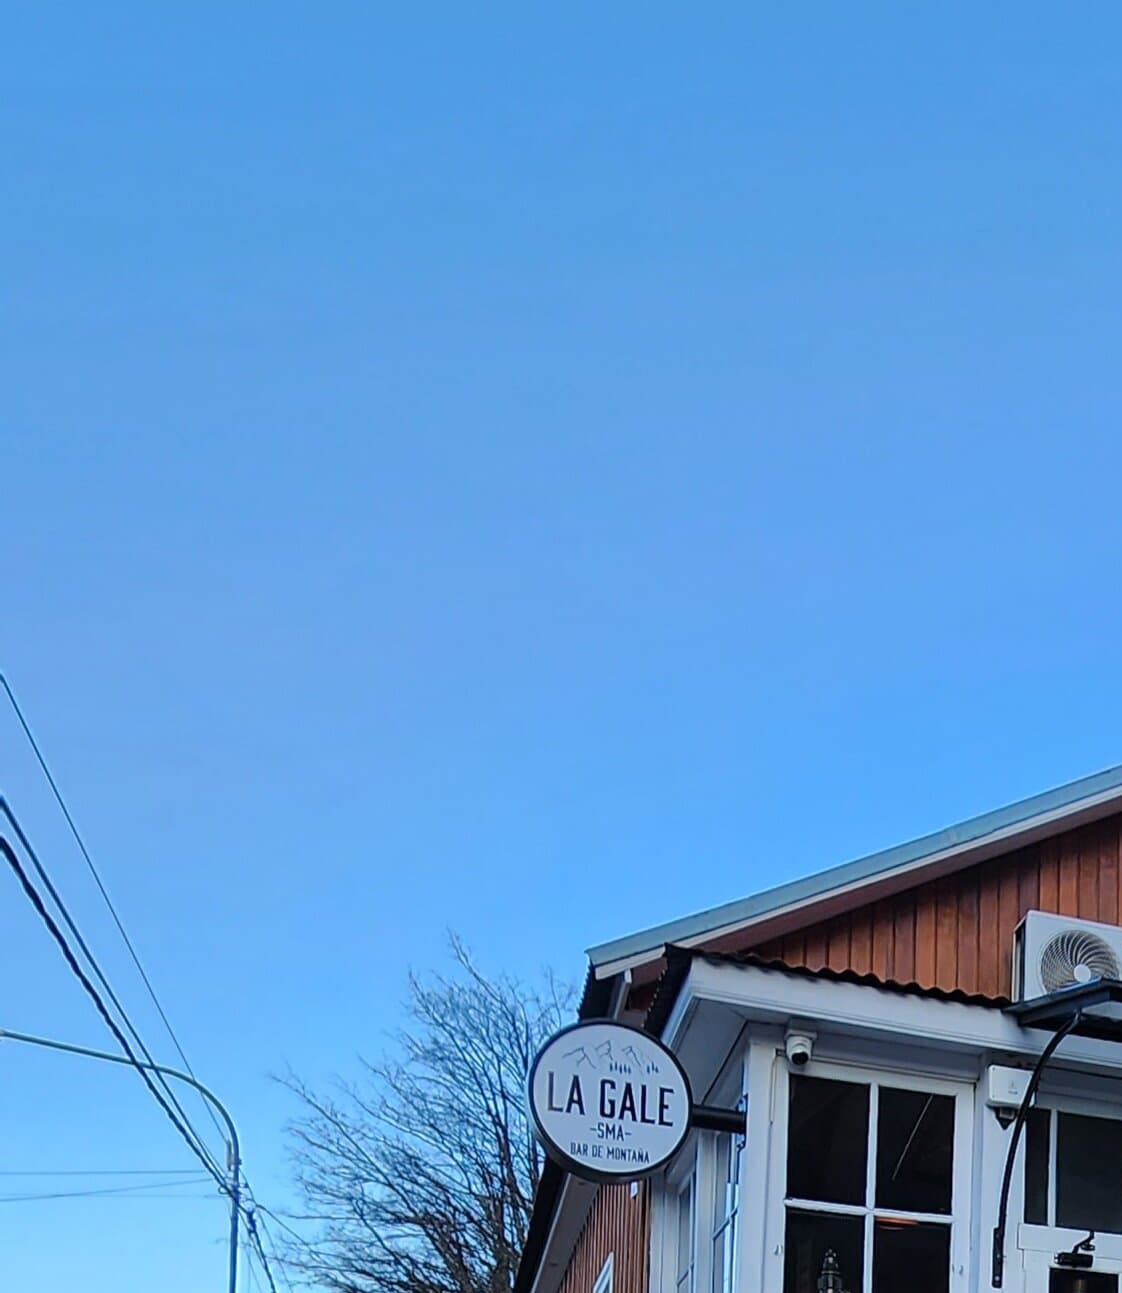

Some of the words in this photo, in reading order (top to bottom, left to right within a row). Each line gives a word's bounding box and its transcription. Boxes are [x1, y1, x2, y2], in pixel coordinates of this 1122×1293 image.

[547, 1071, 585, 1116] LA
[599, 1078, 675, 1127] GALE
[592, 1145, 604, 1159] DE
